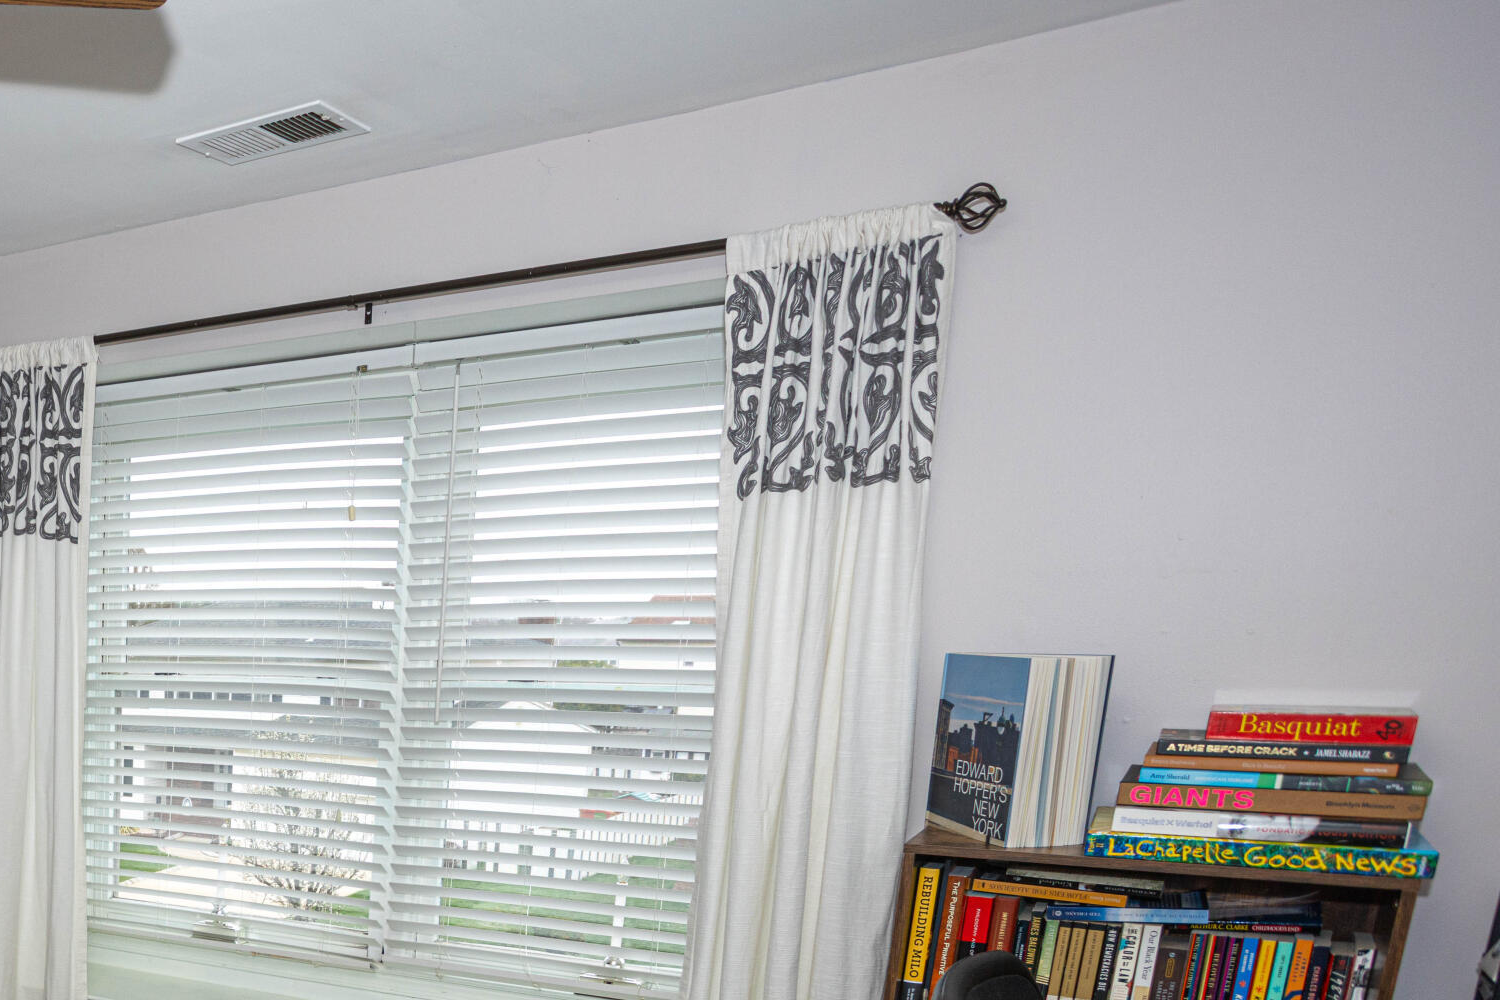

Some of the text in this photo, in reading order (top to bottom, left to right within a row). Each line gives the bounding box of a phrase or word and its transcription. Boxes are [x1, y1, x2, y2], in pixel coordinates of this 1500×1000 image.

[1237, 713, 1362, 741] Basquiat
[1166, 743, 1299, 756] A TIME BEFORE CRACK
[1314, 748, 1372, 760] JAMEL SHABAZZ
[955, 759, 1004, 783] EDWARD
[1150, 772, 1190, 781] Amy Sherald
[953, 776, 1008, 803] HOPPER'S
[1129, 785, 1254, 809] GIANTS
[972, 799, 1000, 819] NEW
[1120, 816, 1164, 827] Basquiat
[1175, 819, 1213, 829] Warhol
[972, 816, 1003, 839] YORK
[1107, 838, 1240, 864] LaChapelle
[1243, 846, 1328, 871] Good
[1335, 852, 1418, 876] News
[1049, 889, 1088, 901] FLOWERS
[909, 876, 933, 978] REBUILDING MILO
[938, 881, 961, 976] THE PURPOSEFUL PRIMITIVE
[971, 908, 981, 938] PHILOSOPHY
[1107, 929, 1116, 942] HOW
[1026, 917, 1041, 965] JAMES BALDWIN
[1123, 934, 1136, 960] COLOR
[1100, 943, 1113, 981] DEMOCRACIES
[1141, 930, 1157, 980] Our Black Year
[1208, 953, 1219, 988] BELOVED
[1310, 965, 1320, 992] CHARLES
[1329, 971, 1345, 1000] 1984
